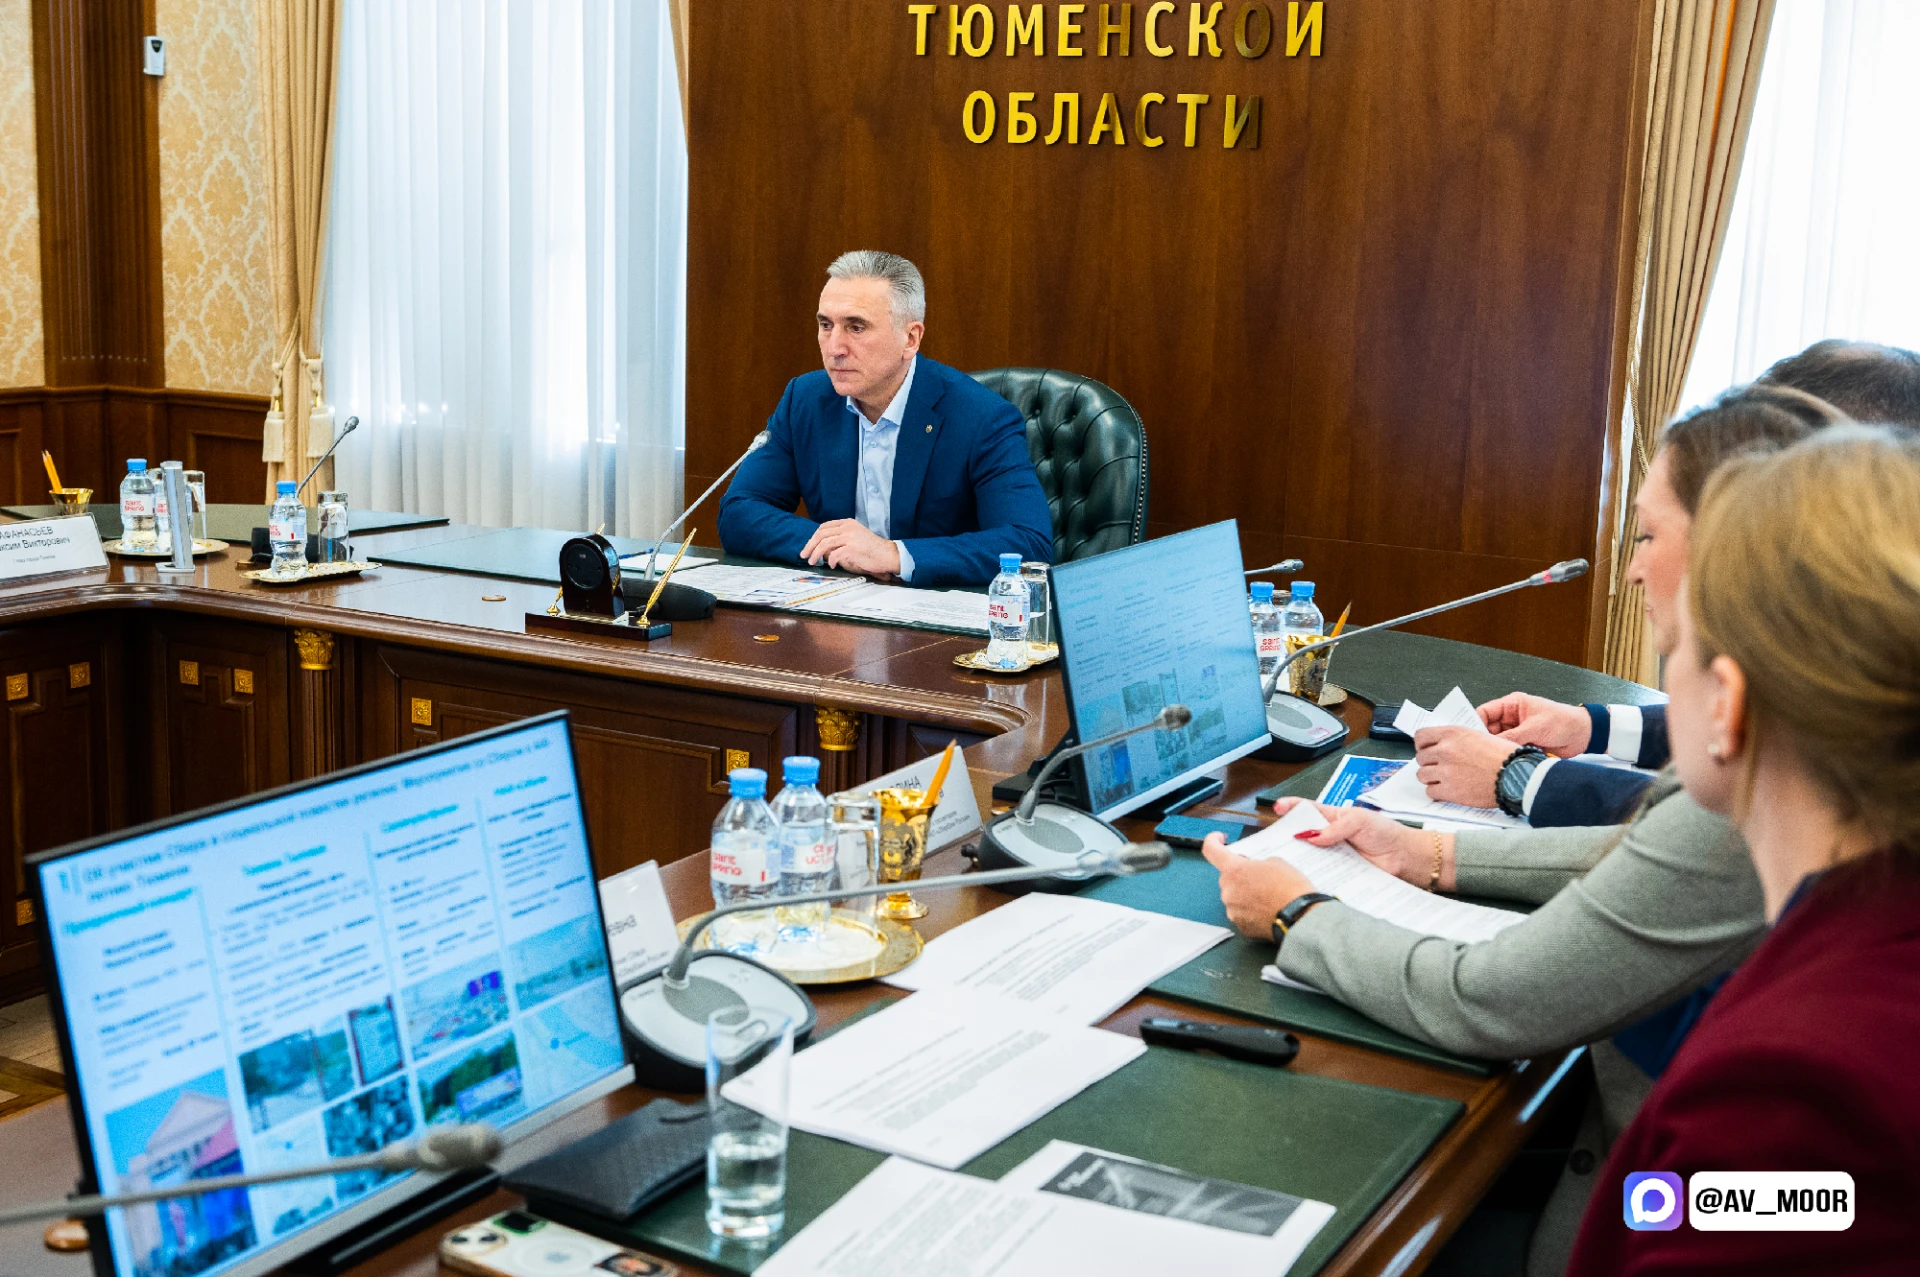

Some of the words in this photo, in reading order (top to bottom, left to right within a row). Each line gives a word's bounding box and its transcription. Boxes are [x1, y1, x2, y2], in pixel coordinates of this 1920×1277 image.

[962, 90, 1260, 149] ОБЛАСТИ
[0, 542, 20, 551] ксим
[22, 537, 70, 548] Викторович
